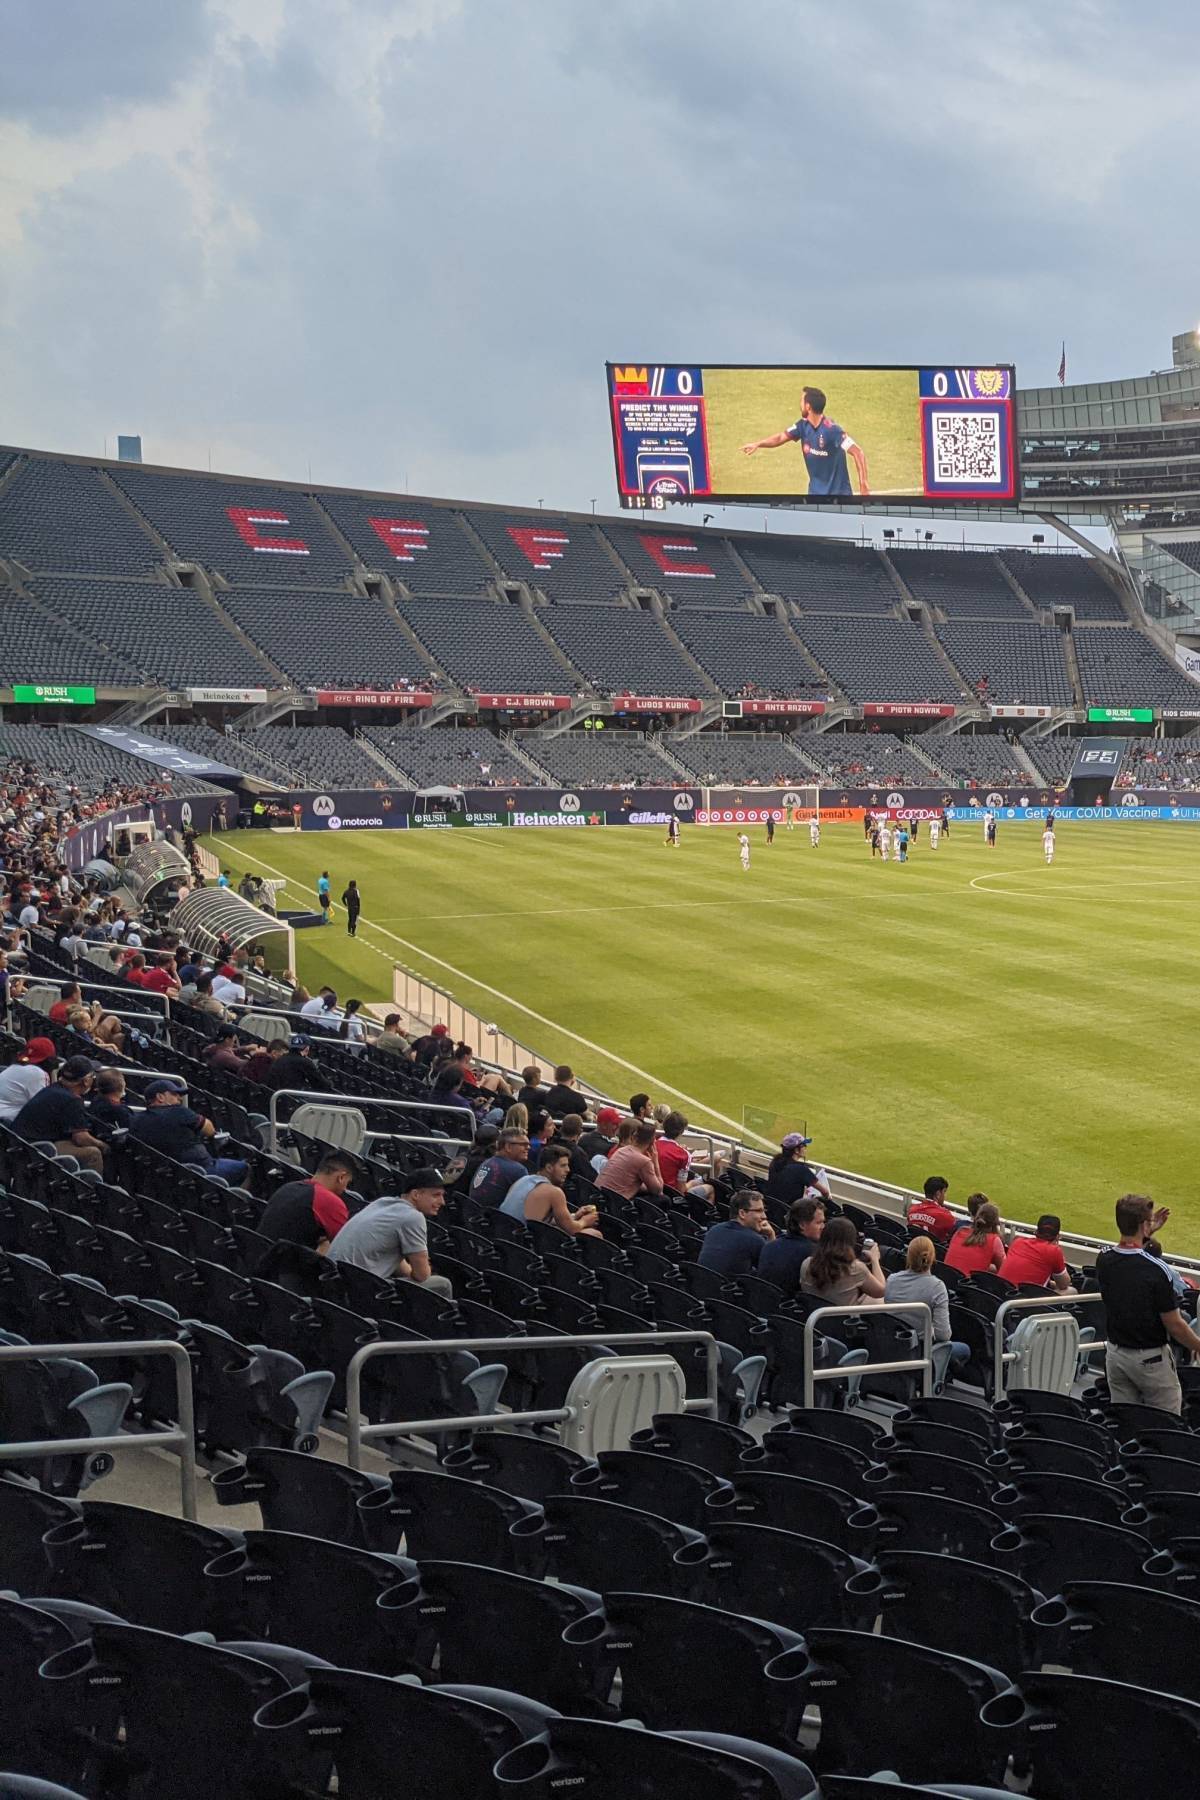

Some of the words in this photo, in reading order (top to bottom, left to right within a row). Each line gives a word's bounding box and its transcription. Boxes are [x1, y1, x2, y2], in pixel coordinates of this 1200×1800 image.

[678, 371, 692, 394] 0
[934, 372, 948, 396] 0
[620, 404, 650, 412] PREDICT
[628, 495, 664, 508] 11:18
[44, 687, 67, 696] RUSH
[202, 692, 241, 701] Heineken
[423, 814, 447, 822] RUSH
[473, 813, 497, 821] RUSH
[629, 812, 672, 824] Gillette
[955, 809, 968, 818] UI
[1024, 808, 1045, 820] Get
[1048, 808, 1074, 820] Your
[1076, 808, 1112, 819] COVID
[1115, 808, 1161, 819] Vaccine!
[1180, 810, 1190, 818] UI
[342, 817, 383, 826] motorola
[513, 812, 586, 826] Heineken
[95, 1459, 105, 1470] 12
[90, 1676, 122, 1685] verizon
[308, 1726, 342, 1735] verizon
[550, 1776, 584, 1788] verizon
